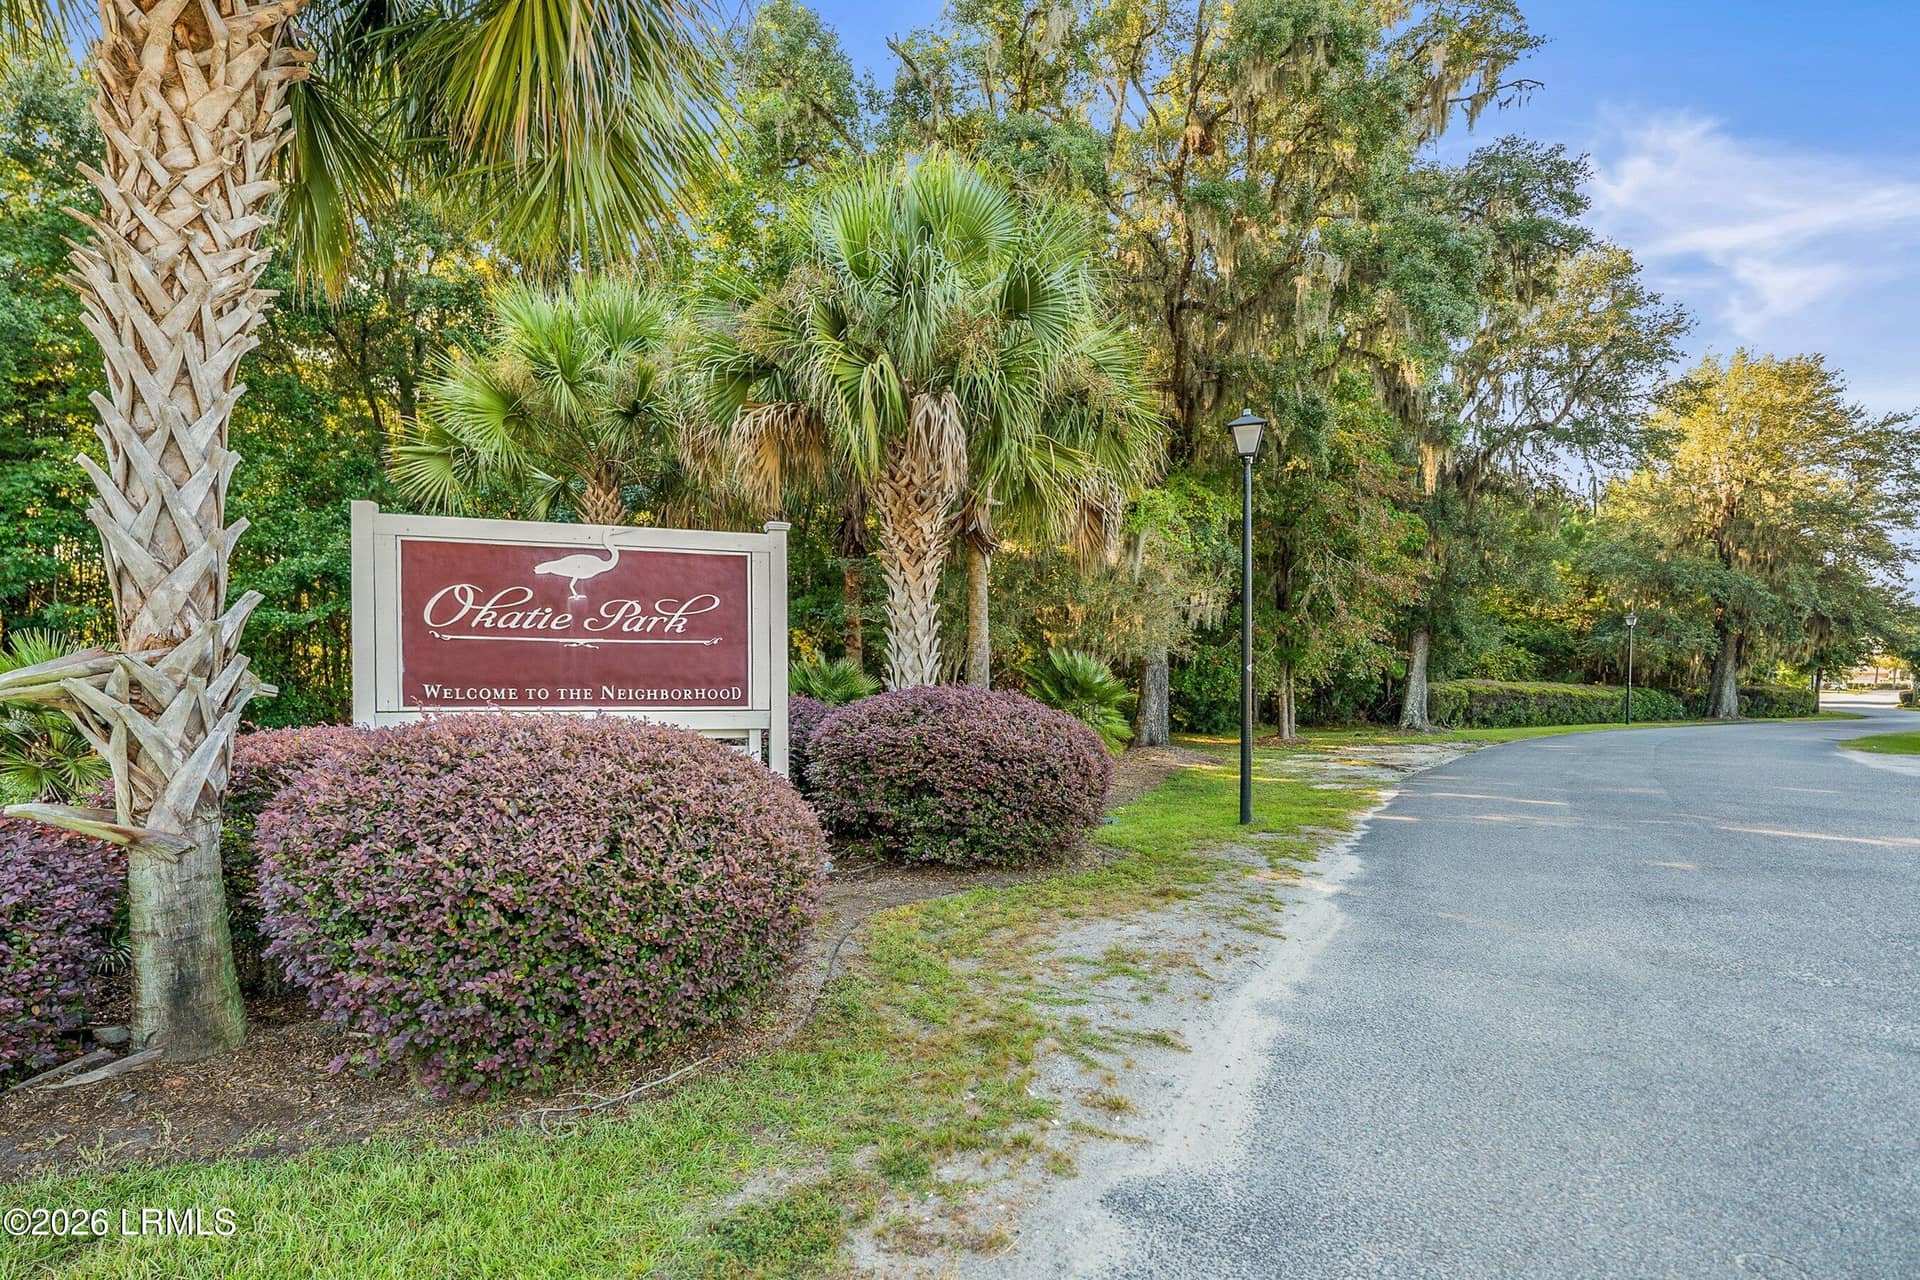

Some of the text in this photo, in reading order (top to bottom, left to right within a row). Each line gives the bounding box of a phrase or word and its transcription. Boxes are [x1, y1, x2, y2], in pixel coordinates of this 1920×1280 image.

[423, 584, 721, 634] Okatie Park
[423, 684, 742, 701] WELCOME TO THE NEIGHBORHOOD
